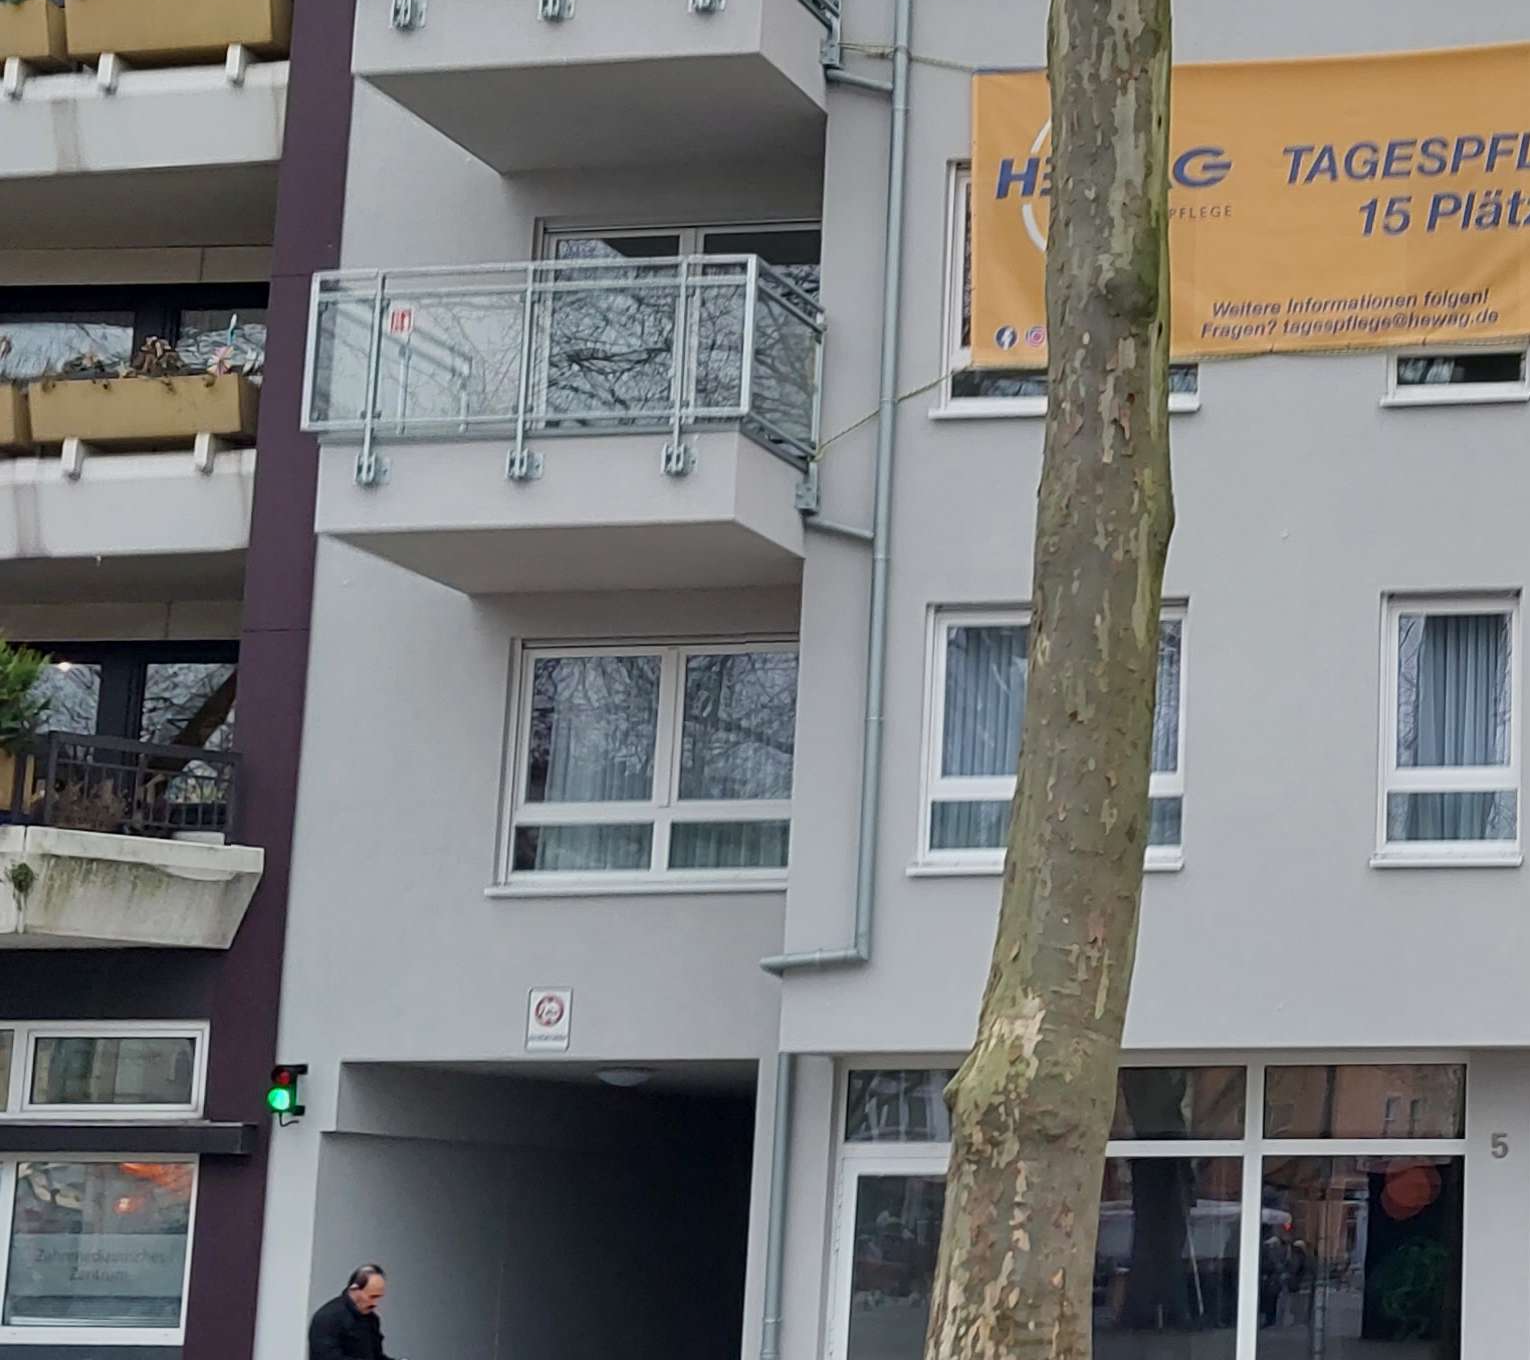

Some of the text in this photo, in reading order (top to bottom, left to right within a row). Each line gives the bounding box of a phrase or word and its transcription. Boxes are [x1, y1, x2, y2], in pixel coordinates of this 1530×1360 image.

[1358, 196, 1413, 237] 15
[1212, 288, 1490, 318] Weitere Informationen folgen!
[1200, 320, 1276, 340] Fragen?
[1491, 1133, 1509, 1159] 5
